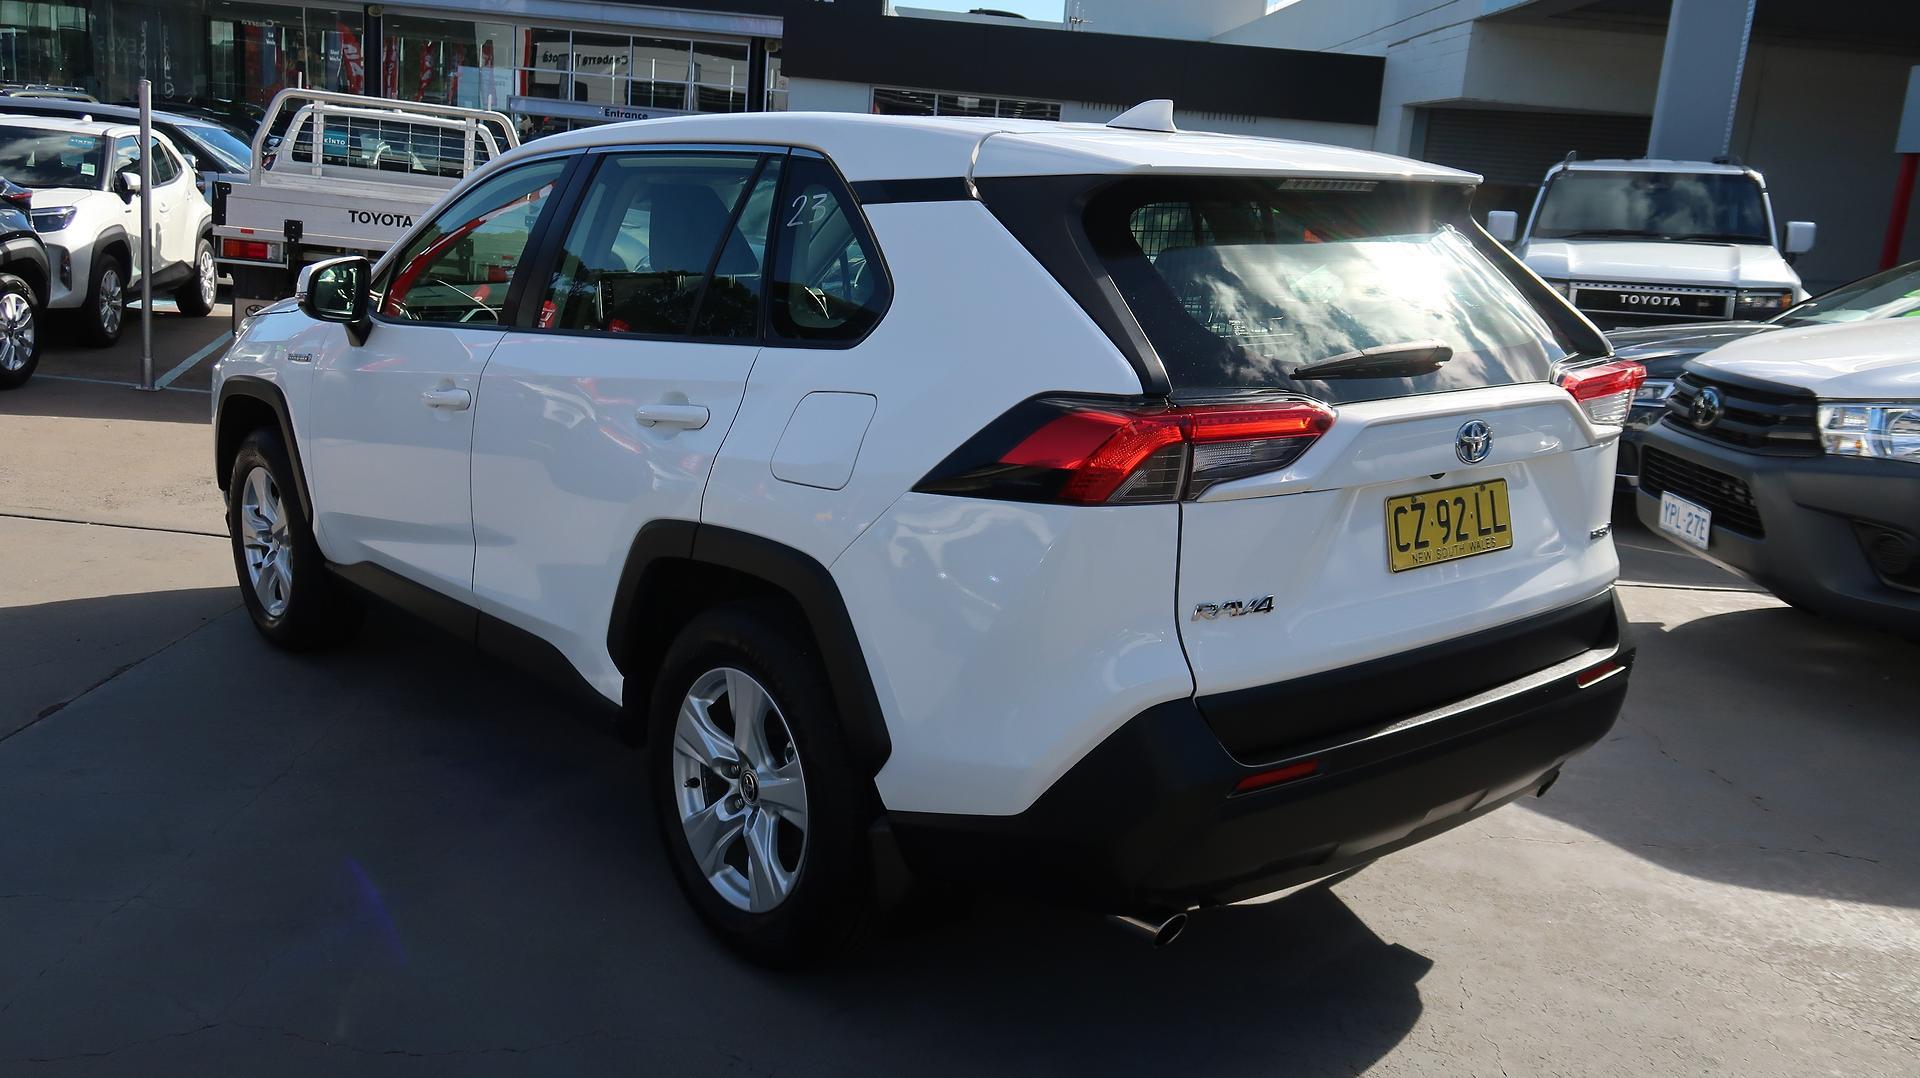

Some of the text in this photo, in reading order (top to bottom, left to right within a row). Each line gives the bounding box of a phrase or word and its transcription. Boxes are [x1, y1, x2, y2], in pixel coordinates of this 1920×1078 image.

[604, 108, 649, 120] Entrance
[348, 210, 414, 228] TOYOTA
[786, 193, 828, 227] 23
[1619, 294, 1681, 307] TOYOTA
[1411, 537, 1497, 565] NEW SOUTH WALES
[1192, 594, 1275, 621] RAV4
